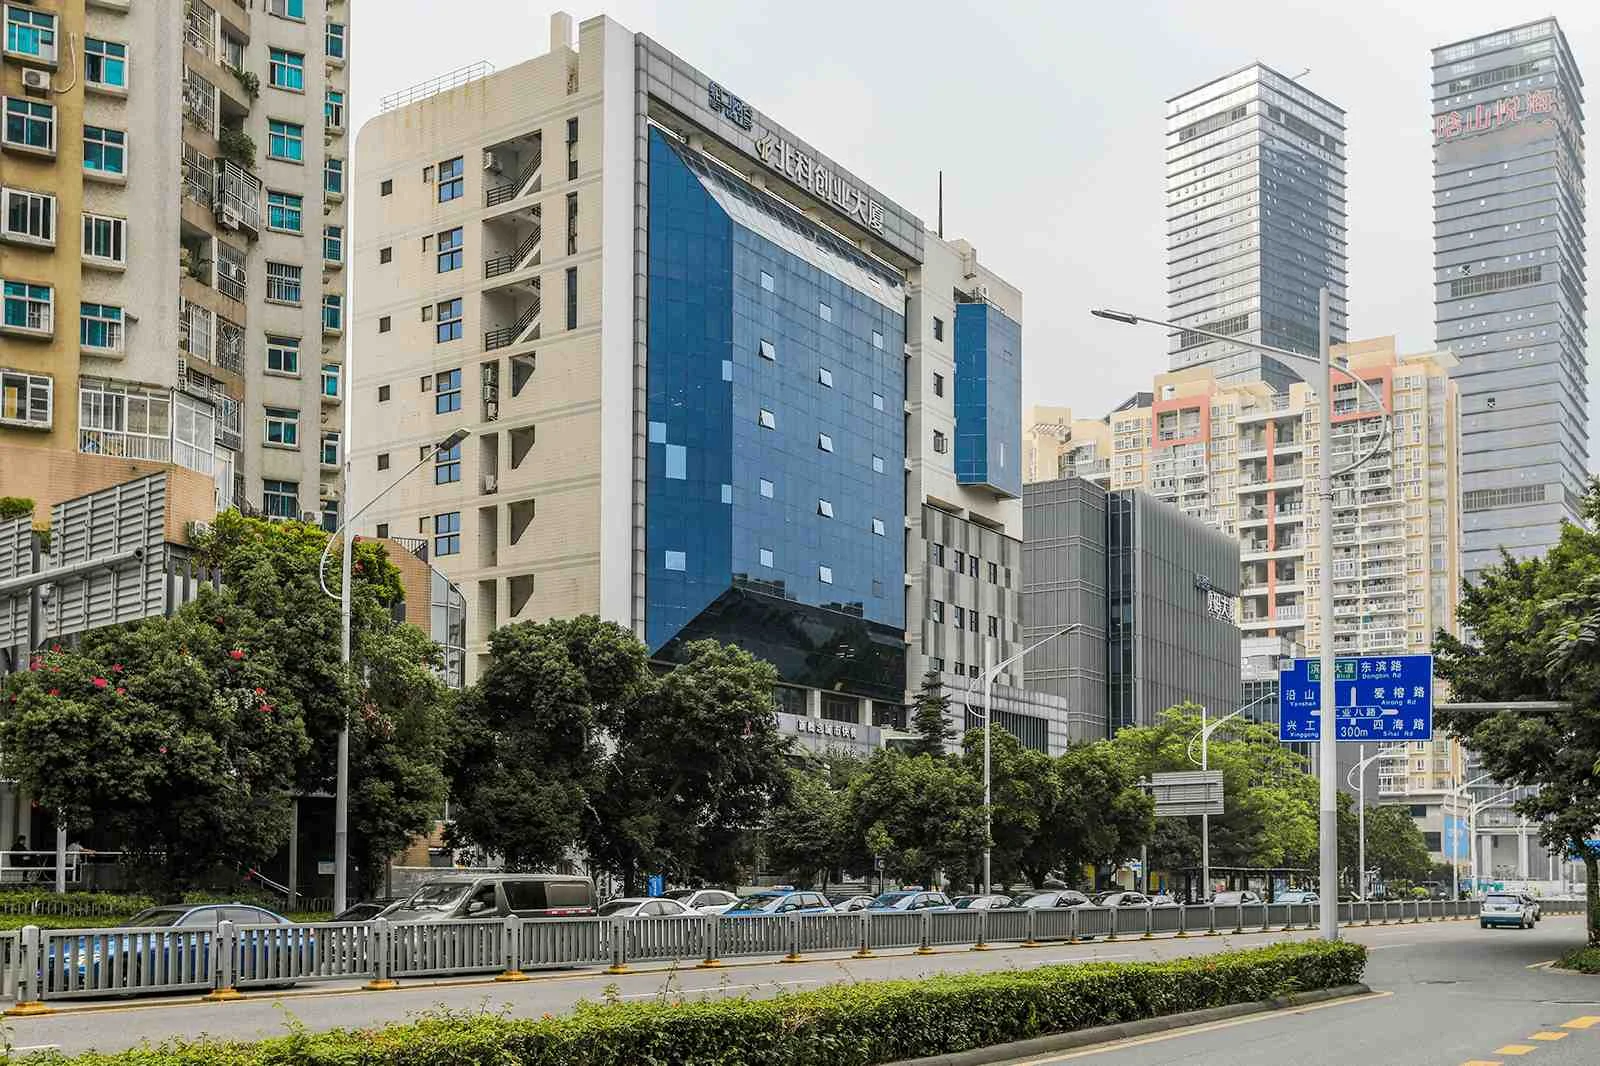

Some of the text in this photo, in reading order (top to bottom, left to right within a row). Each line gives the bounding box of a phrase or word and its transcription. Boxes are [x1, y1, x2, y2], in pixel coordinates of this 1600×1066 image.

[775, 139, 885, 236] 北科创业大厦
[1311, 663, 1354, 673] 滨大道
[1361, 660, 1402, 673] 东滨路
[1374, 686, 1425, 699] 爱榕路
[1373, 718, 1425, 731] 四海路
[1340, 726, 1369, 738] 300m
